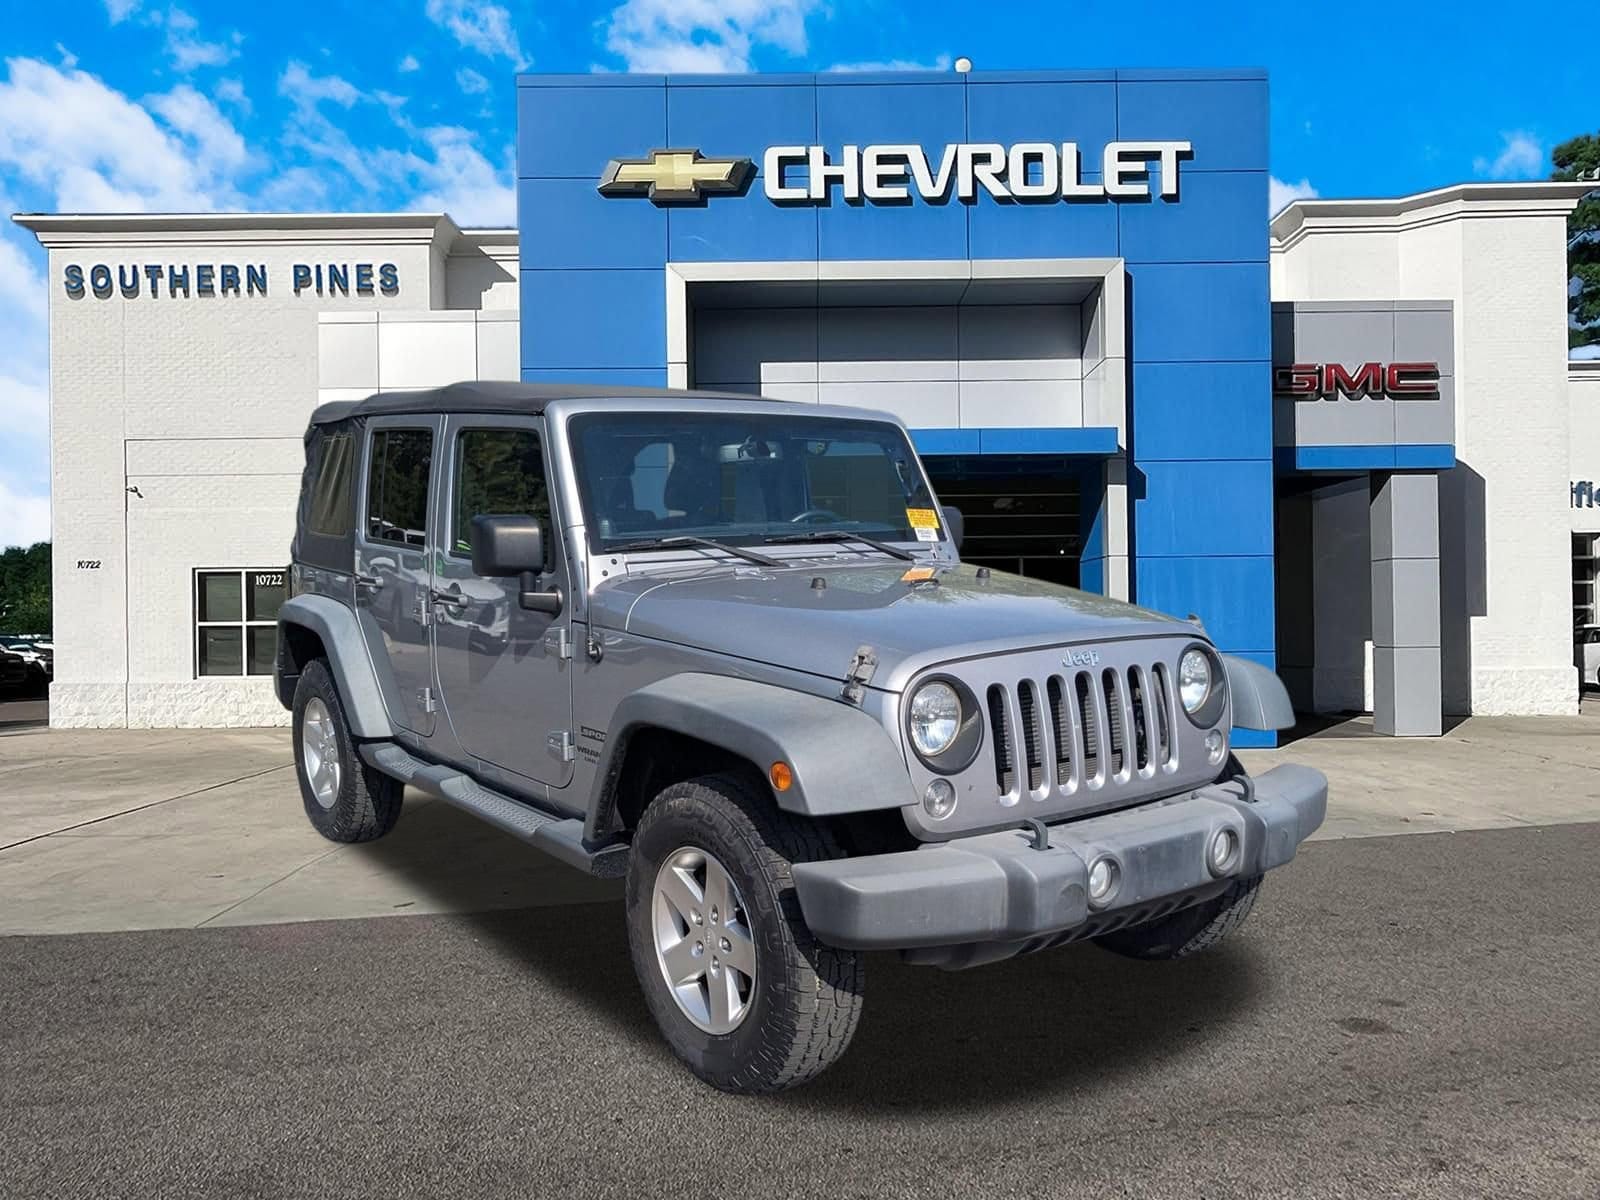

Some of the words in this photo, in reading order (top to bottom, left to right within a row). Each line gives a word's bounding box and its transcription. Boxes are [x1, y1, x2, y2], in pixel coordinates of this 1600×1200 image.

[763, 140, 1194, 206] CHEVROLET
[64, 264, 267, 298] SOUTHERN
[293, 264, 399, 297] PINES
[1275, 362, 1440, 400] GMC
[76, 559, 102, 570] 10722
[255, 574, 284, 587] 10722
[1062, 649, 1100, 668] Jeep
